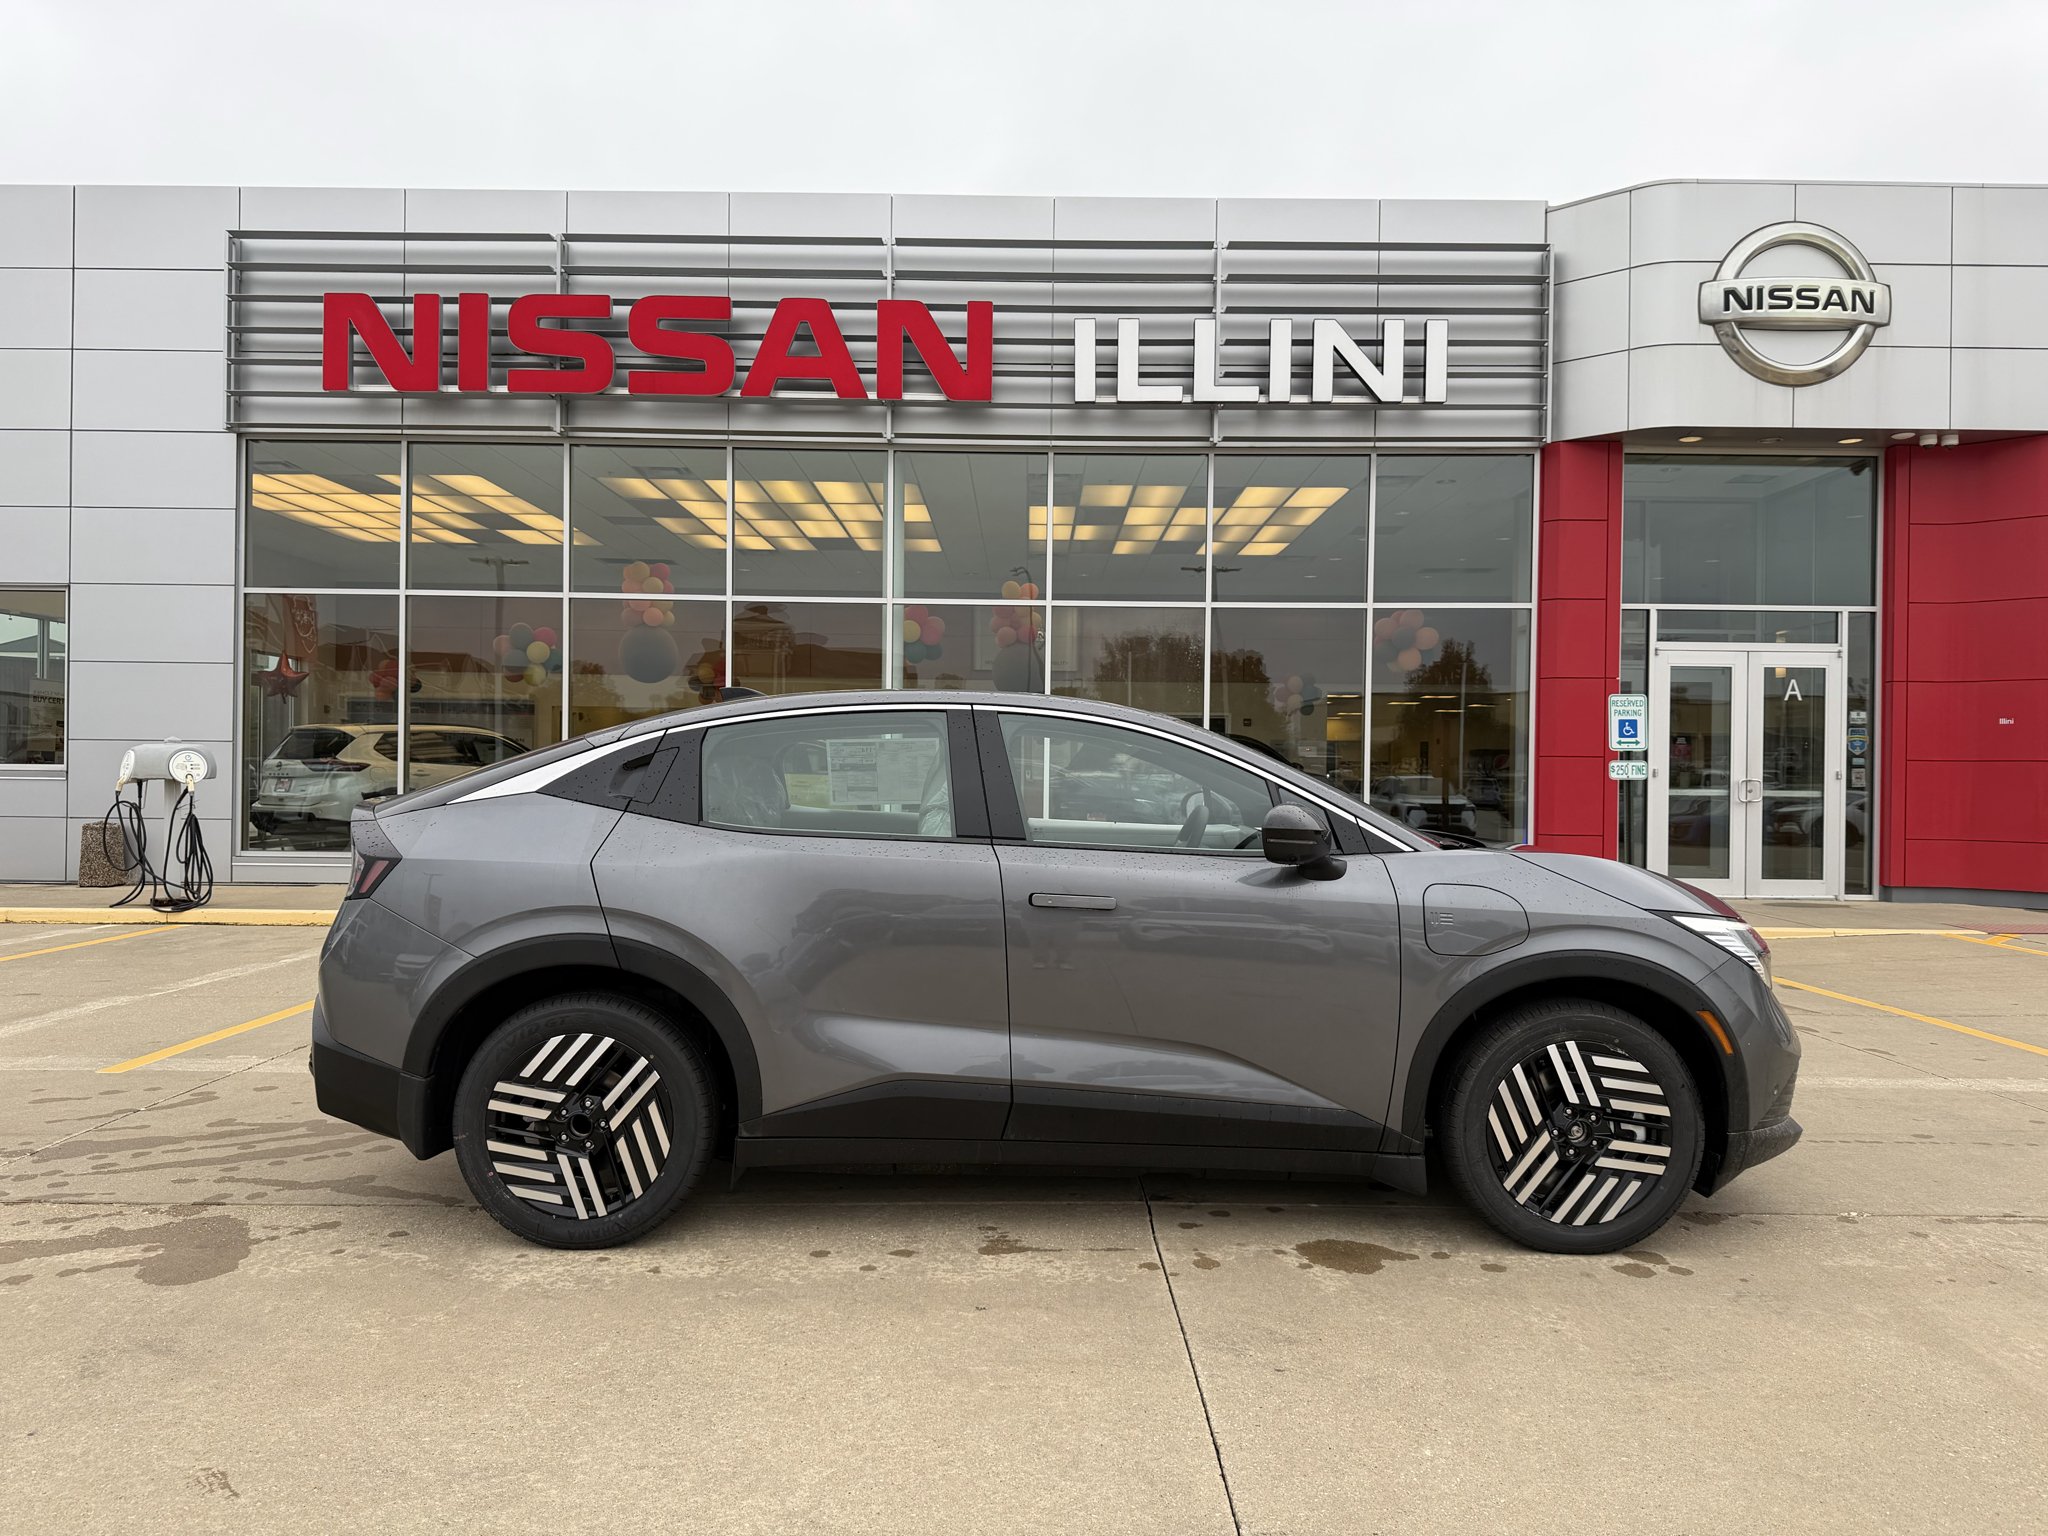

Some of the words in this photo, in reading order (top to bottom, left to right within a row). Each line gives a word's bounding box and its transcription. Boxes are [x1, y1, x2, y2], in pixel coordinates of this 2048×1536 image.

[1723, 285, 1875, 314] NISSAN
[323, 291, 993, 401] NISSAN
[1074, 318, 1449, 403] ILLINI
[1784, 679, 1802, 701] A
[1611, 699, 1644, 708] RESERVED
[1613, 709, 1642, 717] PARKING
[1610, 764, 1629, 776] $250
[1631, 764, 1646, 776] FINE
